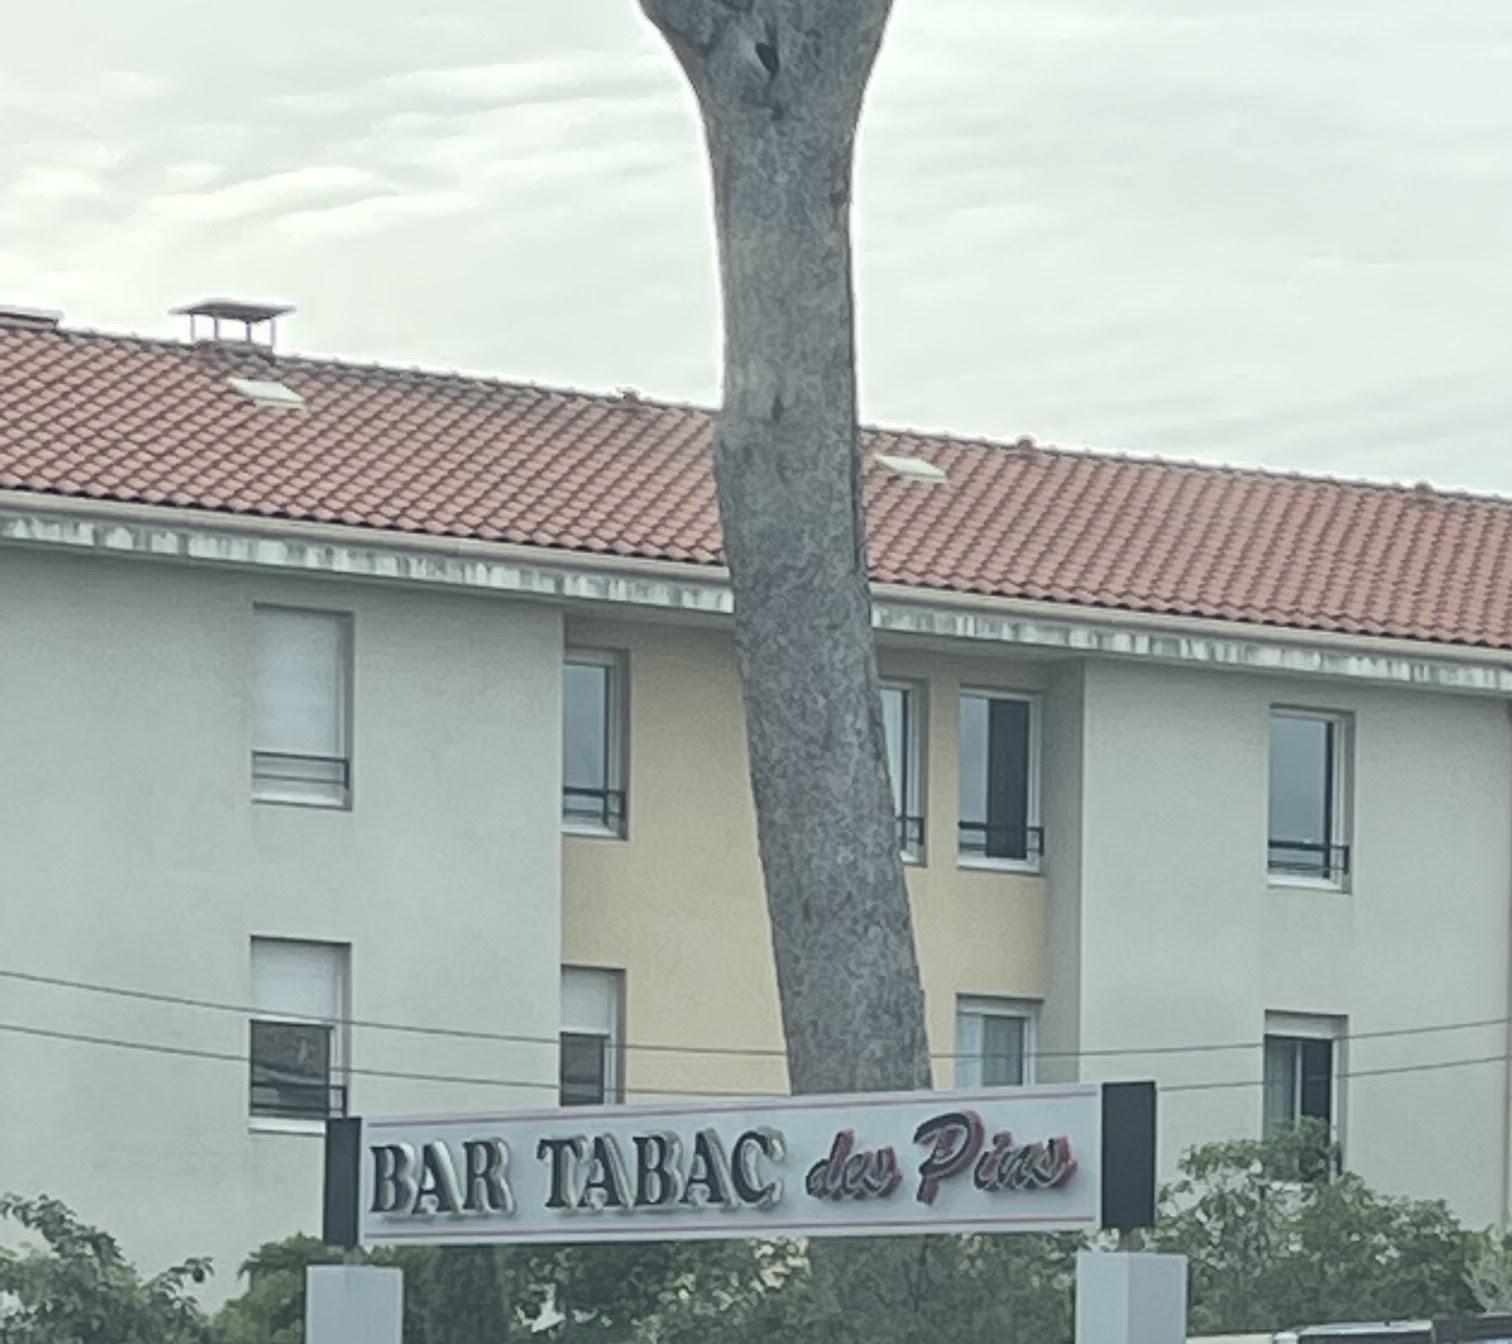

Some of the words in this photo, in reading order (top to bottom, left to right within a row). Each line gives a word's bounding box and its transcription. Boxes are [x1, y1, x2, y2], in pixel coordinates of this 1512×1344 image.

[369, 1135, 516, 1219] BAR
[536, 1127, 786, 1213] TABAC
[806, 1128, 902, 1200] des
[914, 1110, 1078, 1207] Pins
